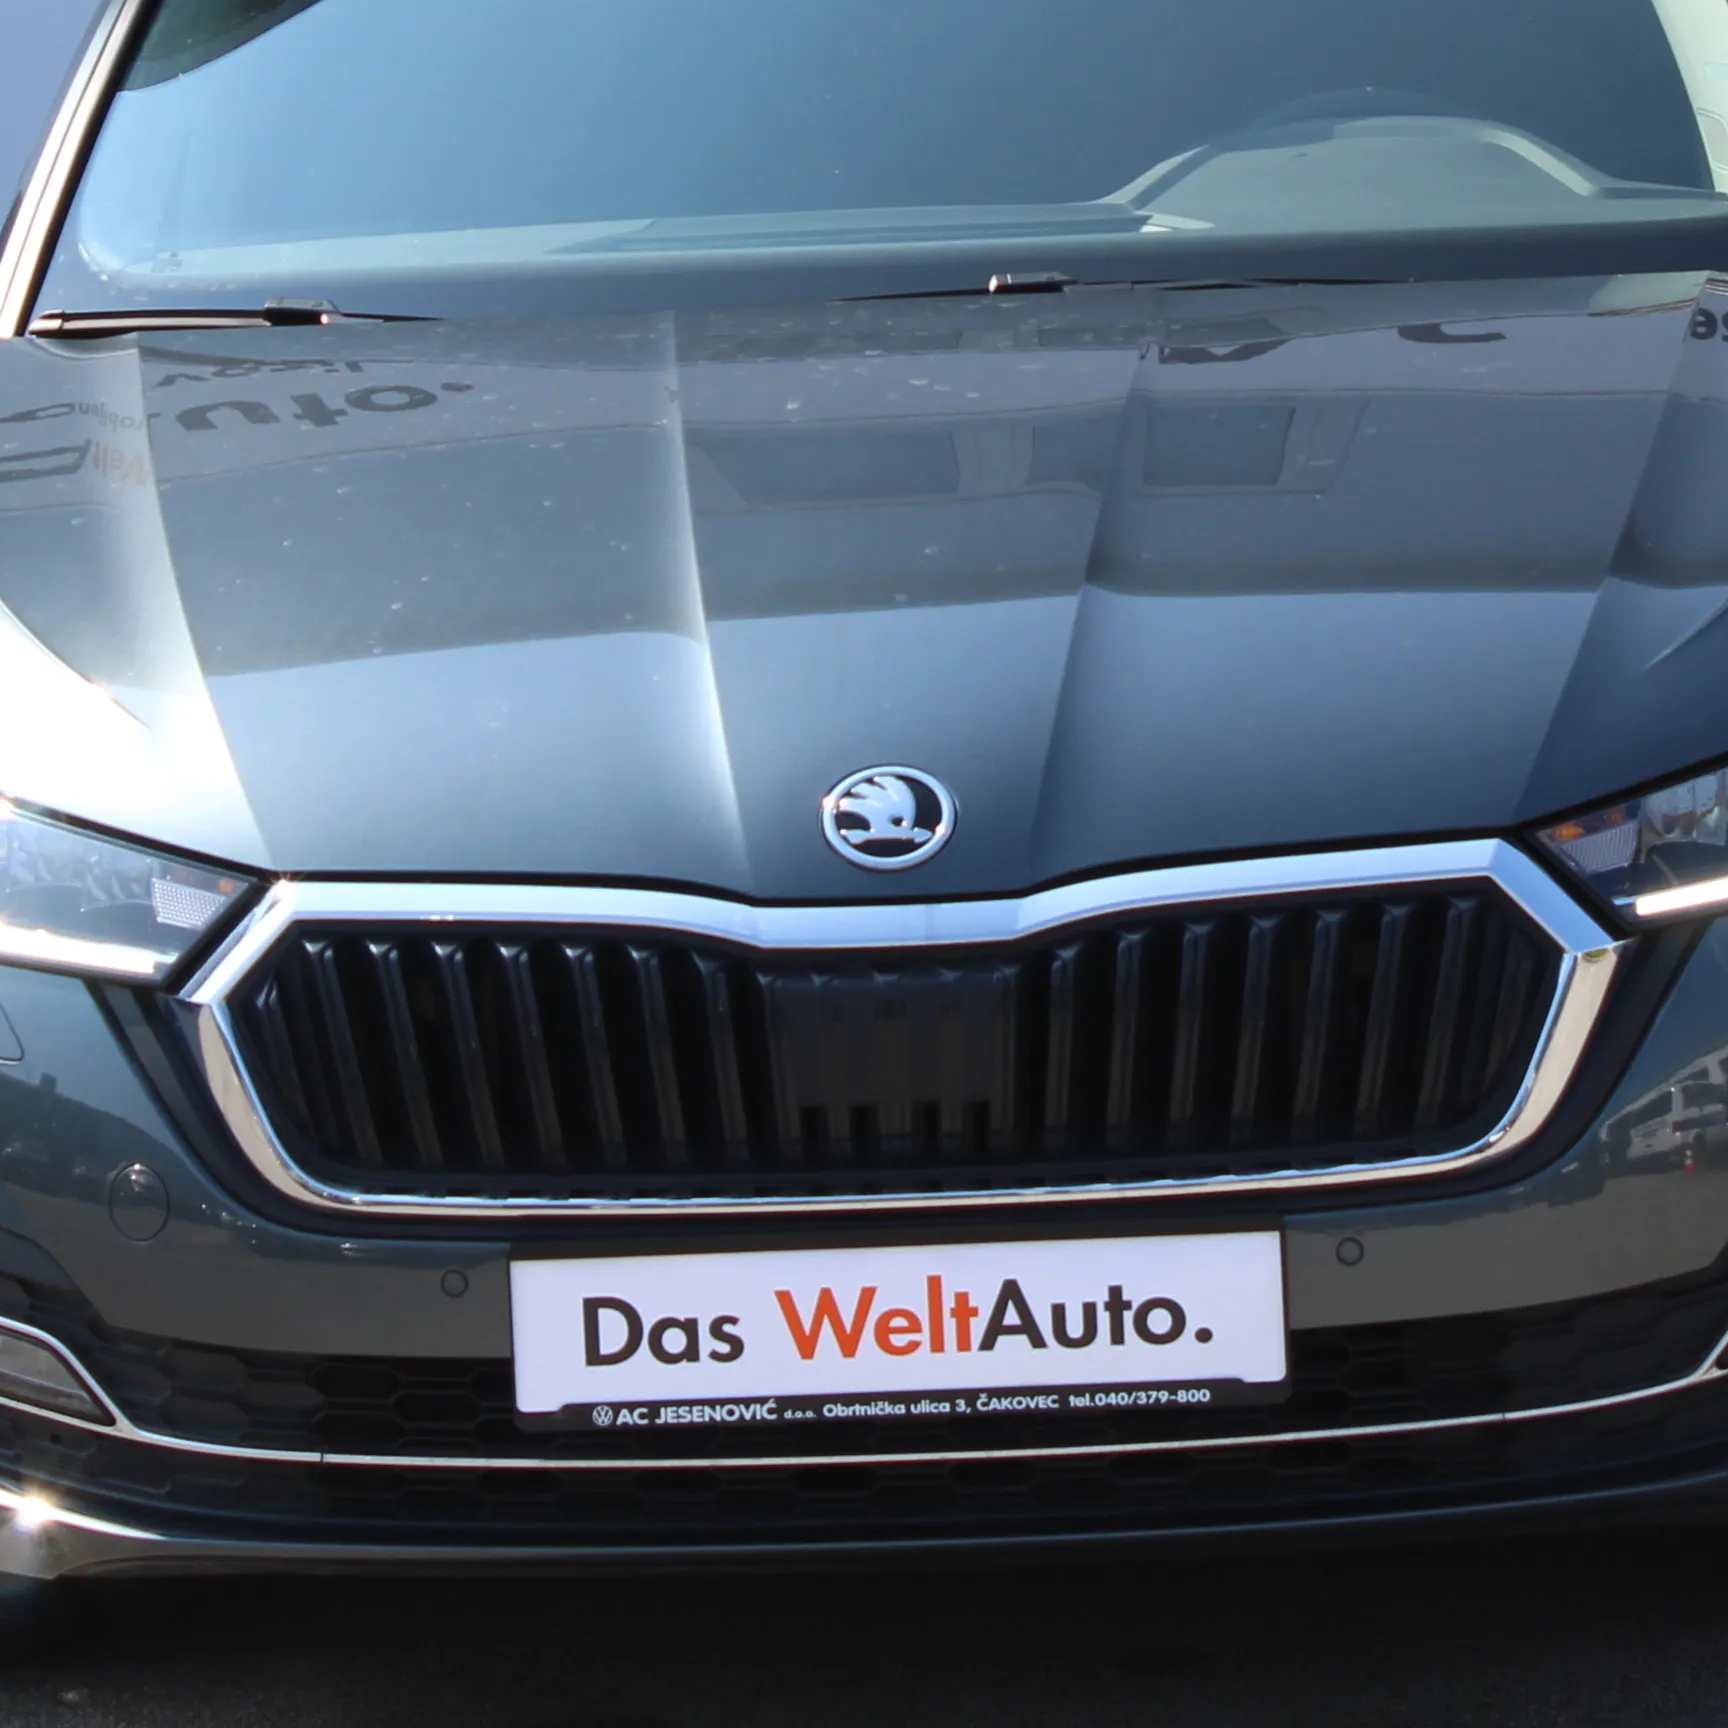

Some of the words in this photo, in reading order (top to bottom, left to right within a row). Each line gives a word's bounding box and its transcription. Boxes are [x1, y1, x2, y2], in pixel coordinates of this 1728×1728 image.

[582, 1296, 745, 1367] Das
[775, 1275, 1213, 1360] WeltAuto.
[615, 1407, 649, 1426] AC
[654, 1398, 778, 1424] JESENOVIĆ
[910, 1399, 951, 1414] ulica
[955, 1398, 972, 1414] 3,
[976, 1392, 1060, 1412] ČAKOVEC
